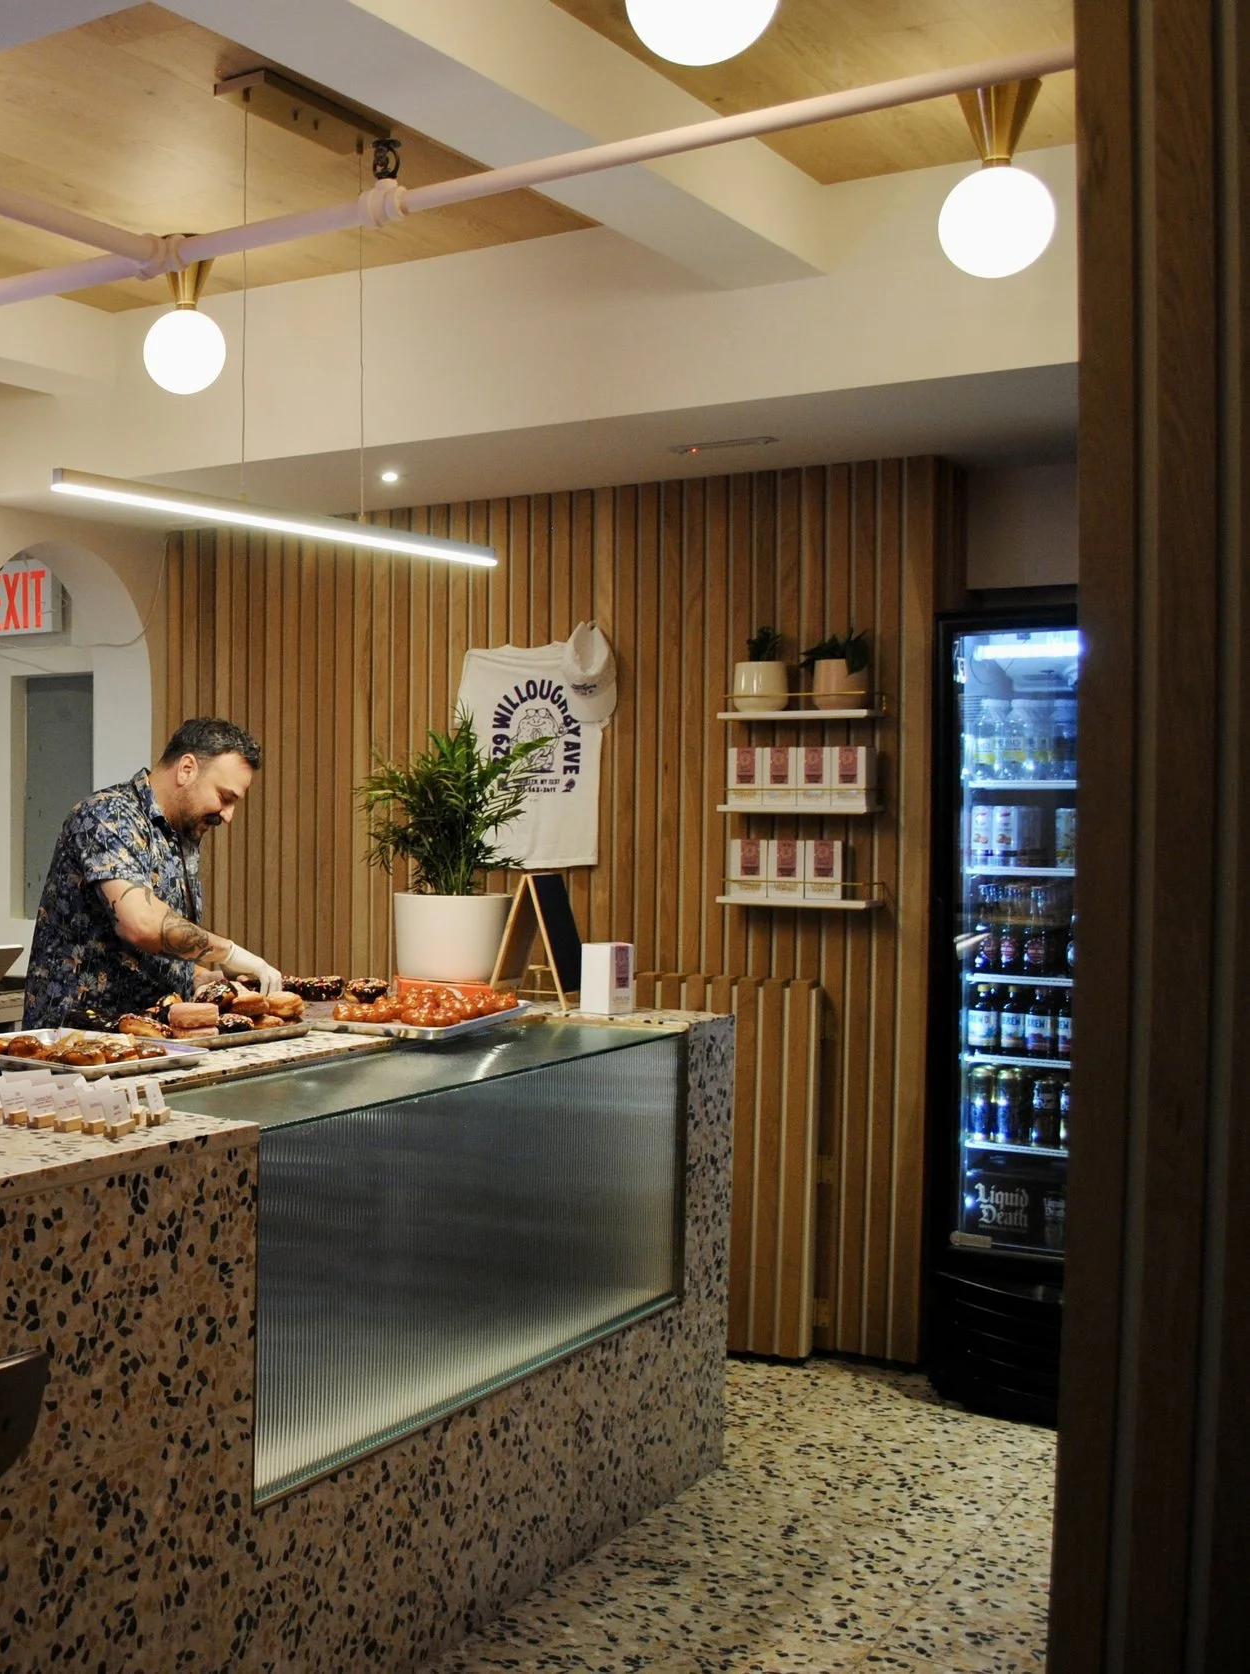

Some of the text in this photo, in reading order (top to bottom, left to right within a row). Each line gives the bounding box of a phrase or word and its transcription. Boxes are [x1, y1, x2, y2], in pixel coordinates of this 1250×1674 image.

[563, 741, 581, 776] AVE
[974, 1182, 1029, 1209] Liquid
[978, 1203, 1029, 1227] Death
